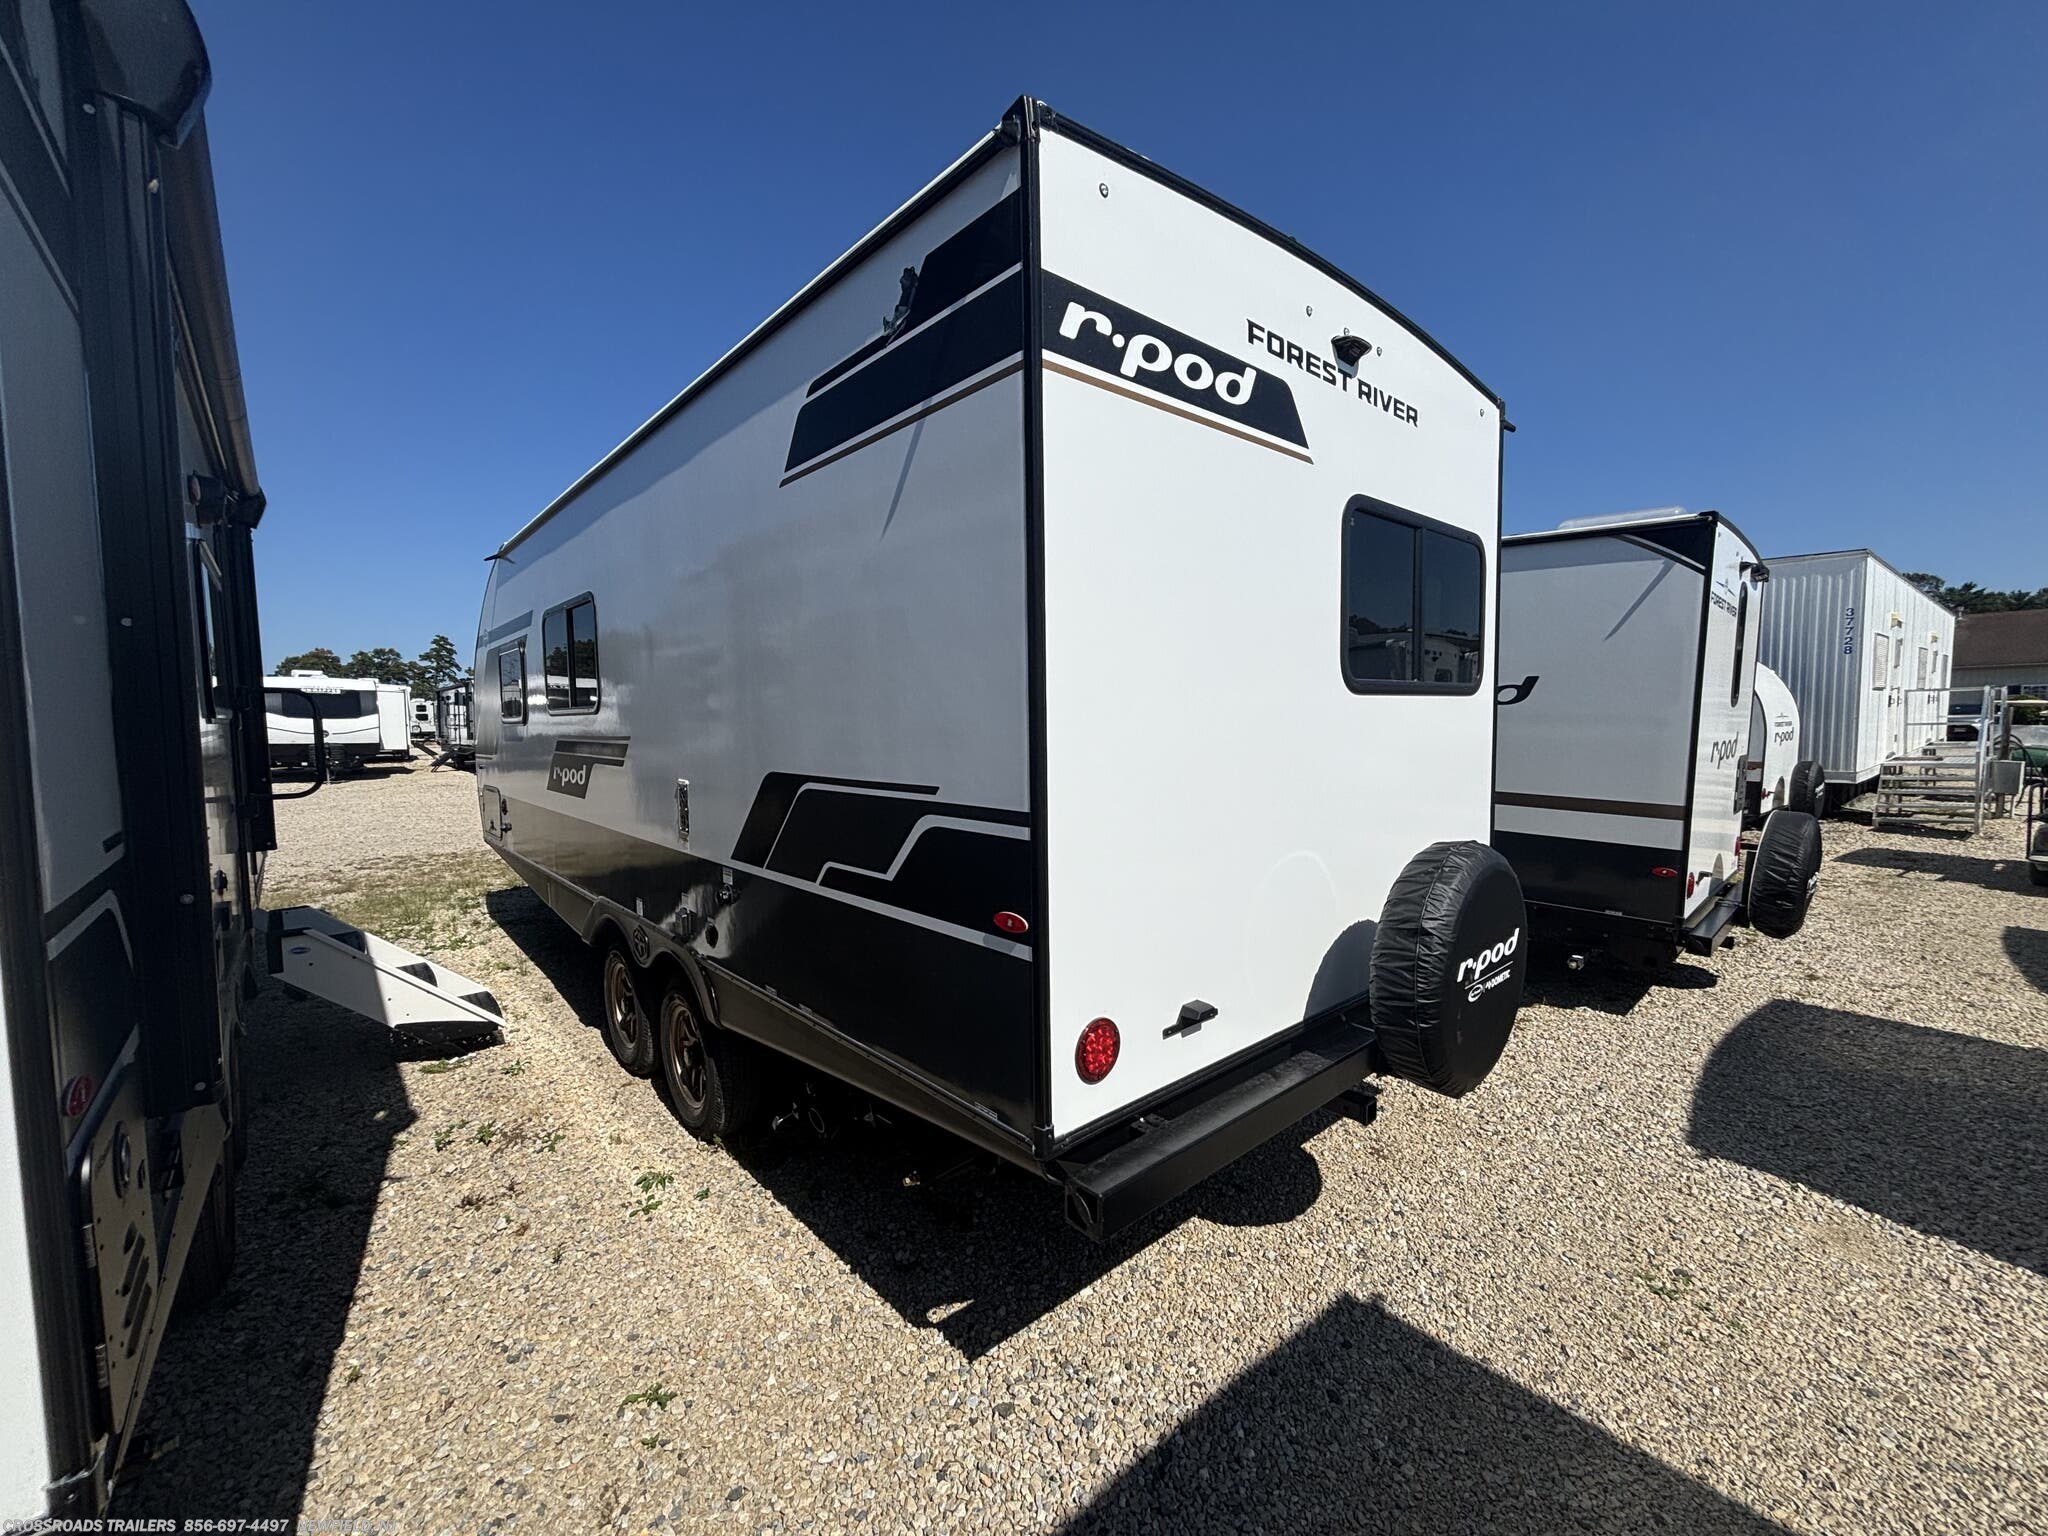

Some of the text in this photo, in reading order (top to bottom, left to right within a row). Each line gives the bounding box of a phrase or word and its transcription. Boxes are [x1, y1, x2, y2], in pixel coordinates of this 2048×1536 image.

[1246, 318, 1418, 427] FOREST RIVER
[1843, 607, 1855, 655] 37728
